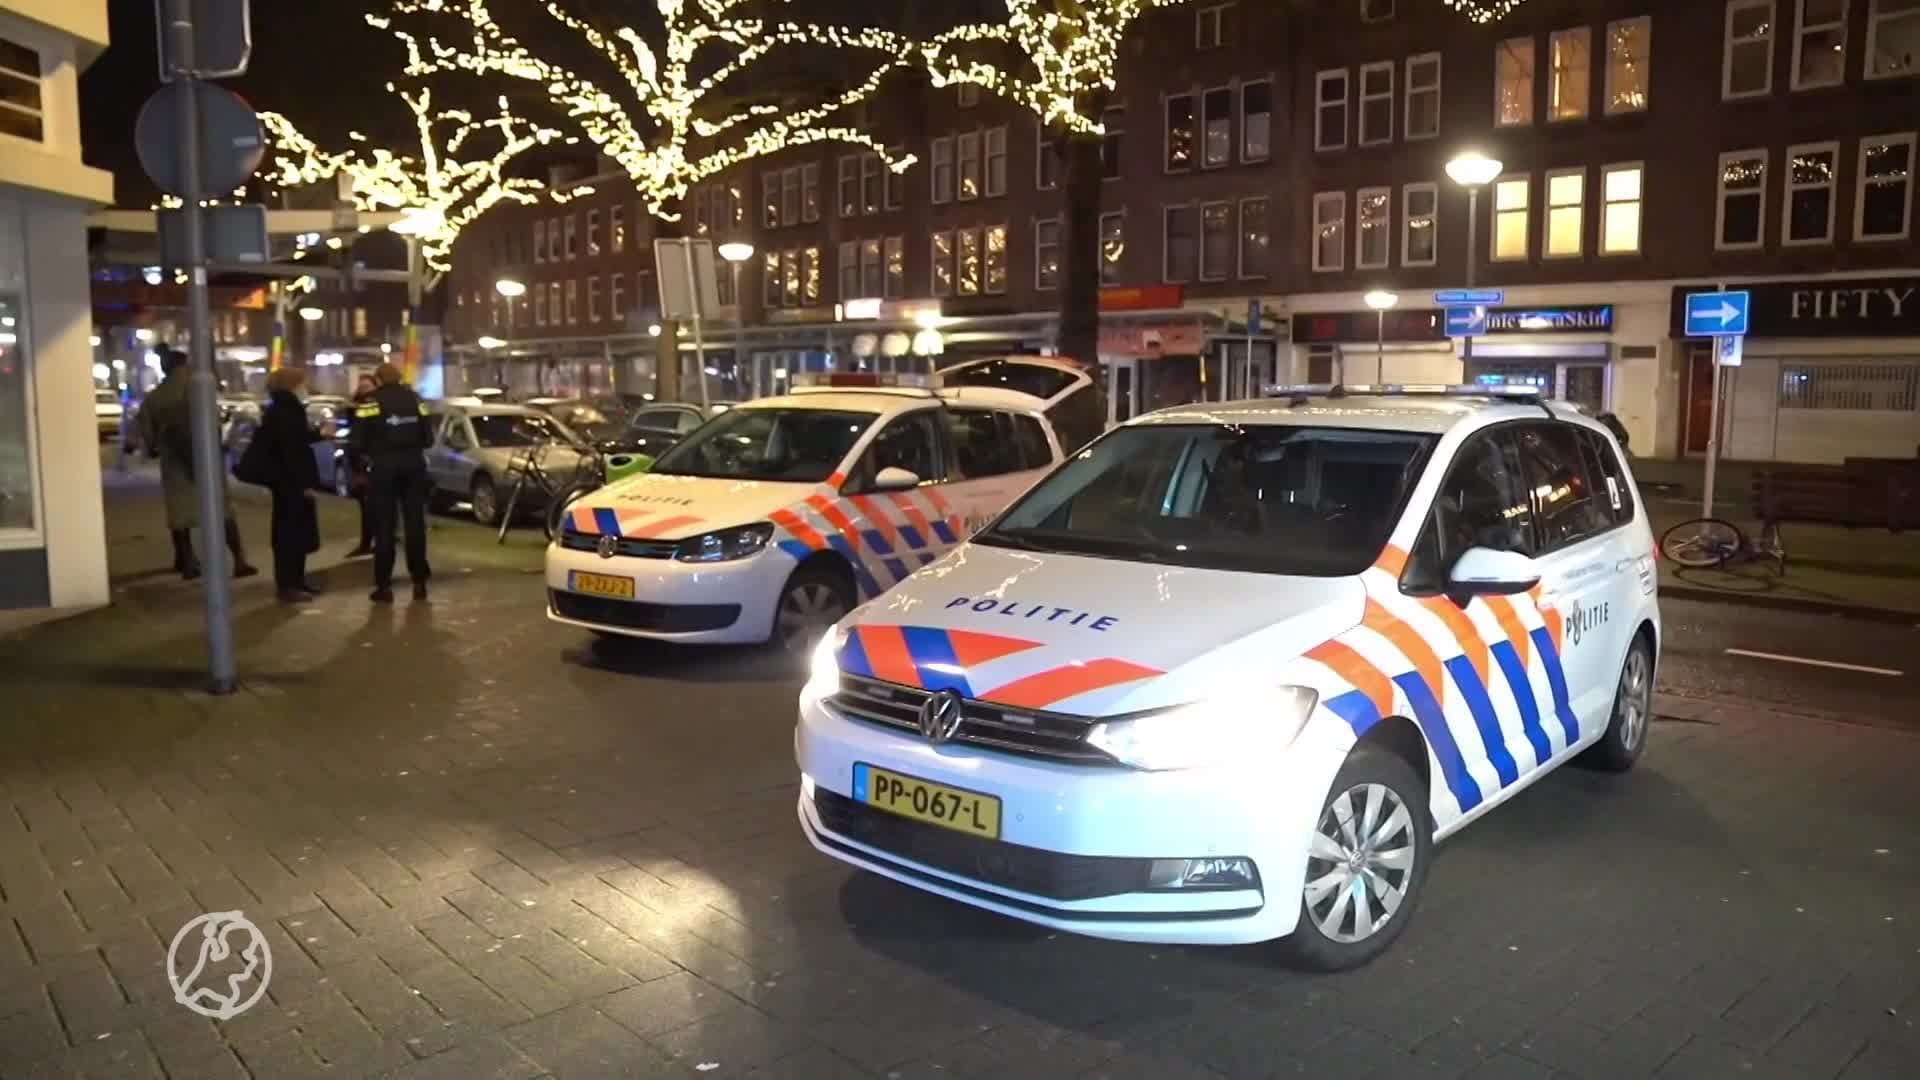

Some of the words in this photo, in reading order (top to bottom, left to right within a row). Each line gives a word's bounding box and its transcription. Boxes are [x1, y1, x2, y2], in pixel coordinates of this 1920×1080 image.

[1791, 288, 1915, 319] FIFTY
[945, 597, 1120, 632] POLITIE
[874, 774, 987, 831] PP-067-L
